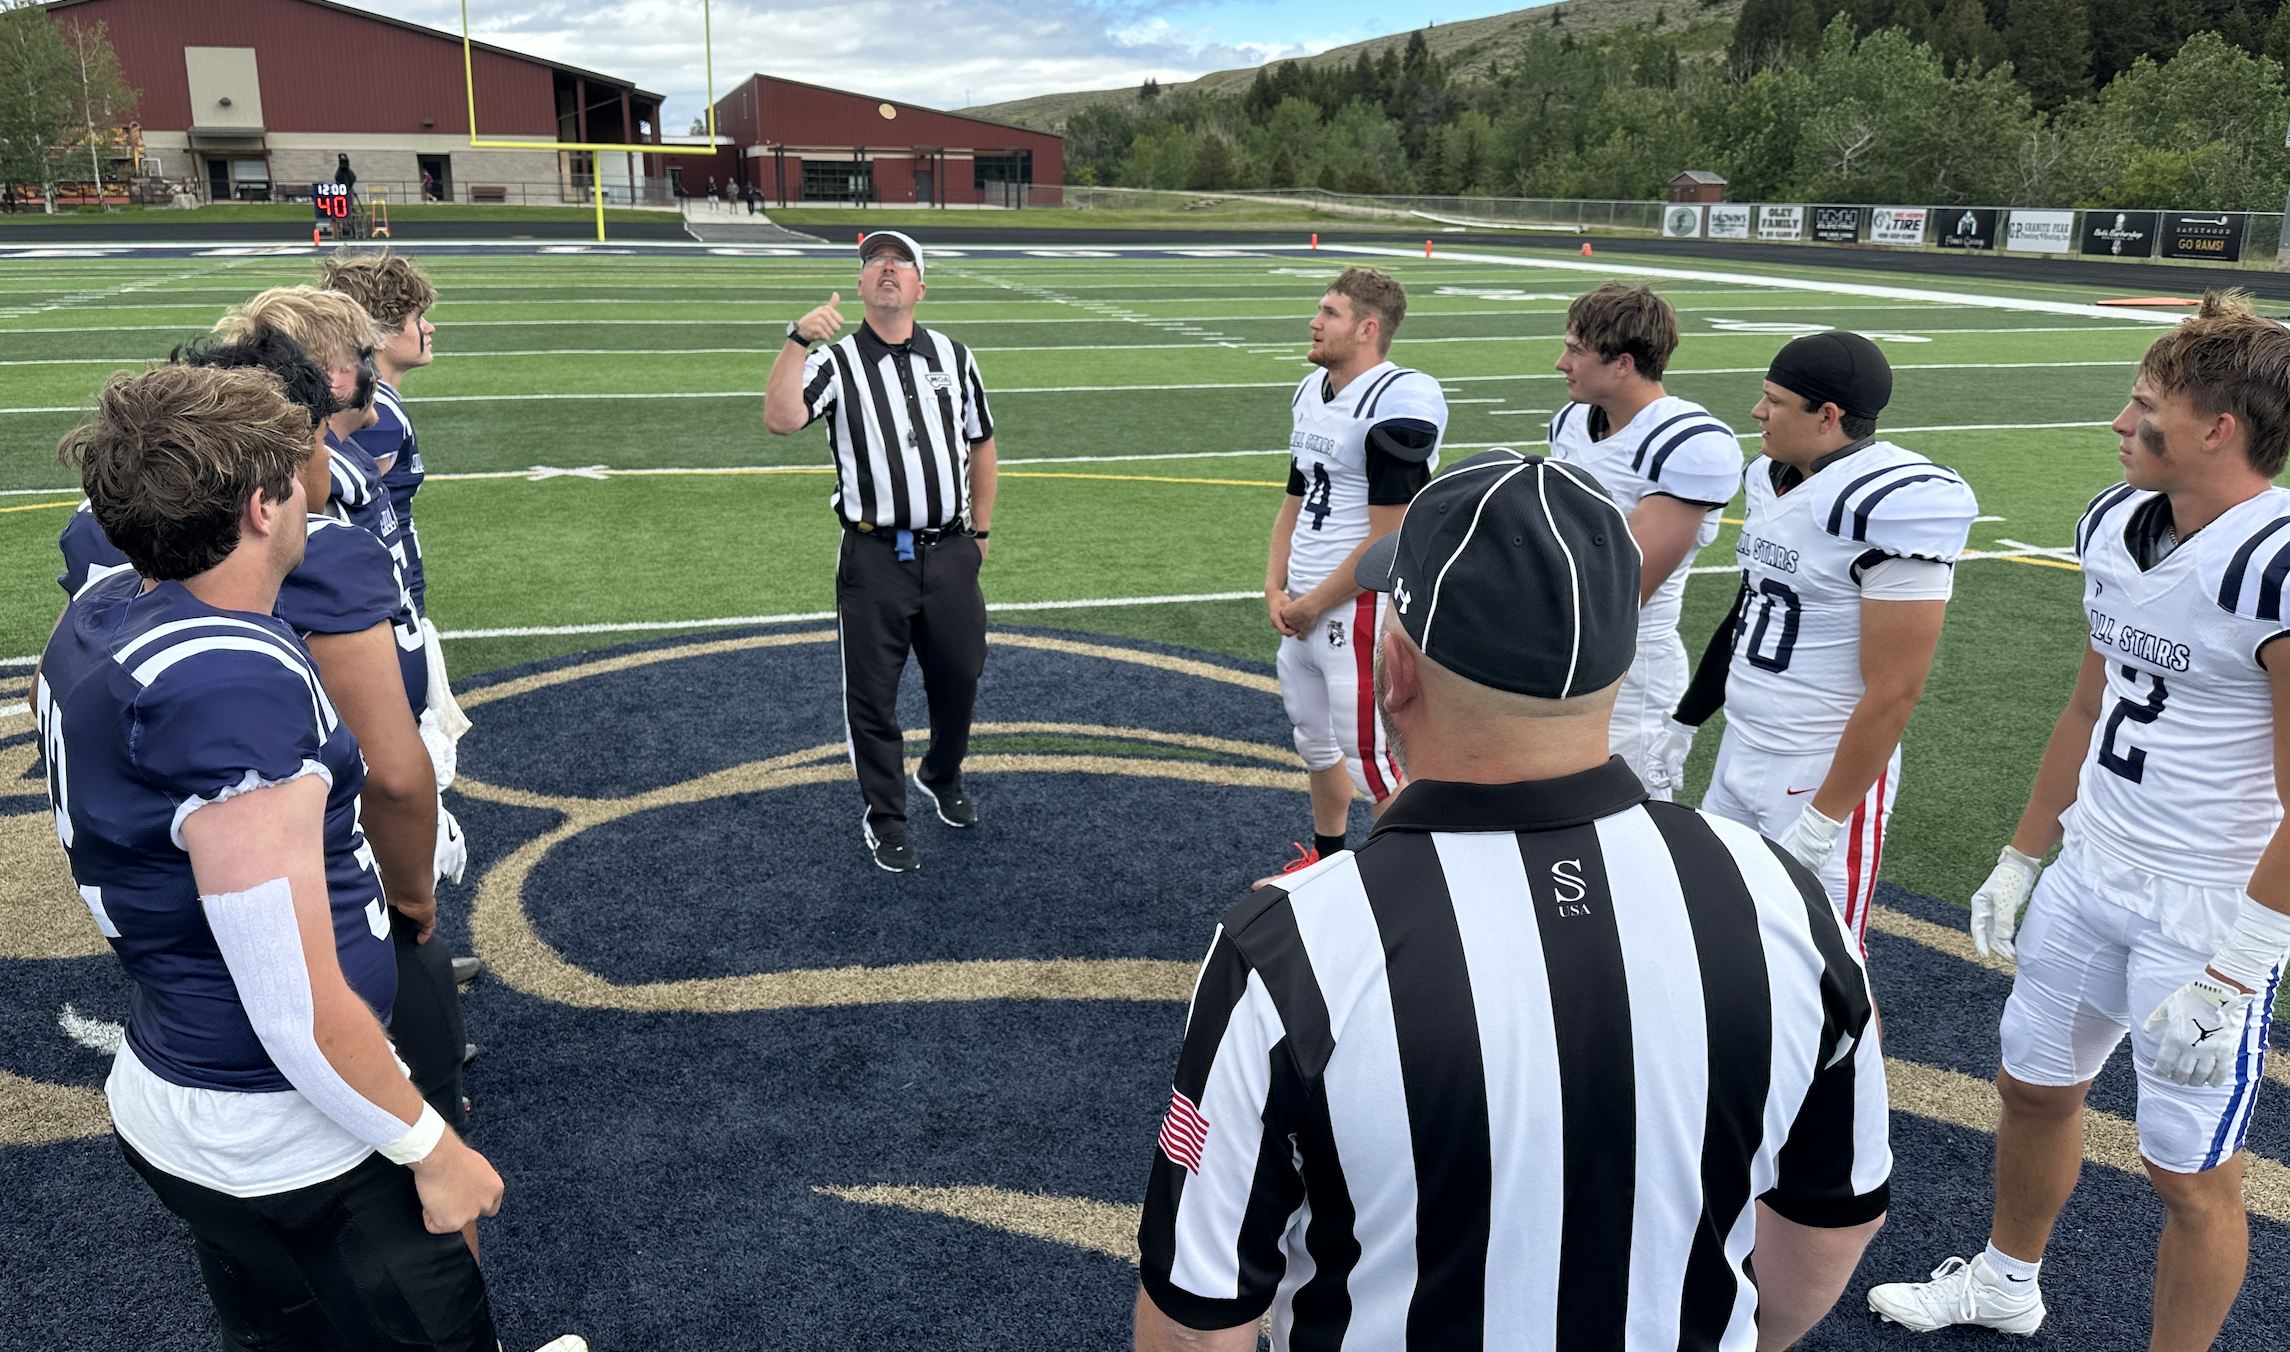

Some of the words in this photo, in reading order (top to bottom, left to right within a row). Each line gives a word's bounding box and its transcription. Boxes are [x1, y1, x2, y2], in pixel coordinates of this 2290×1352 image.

[317, 183, 348, 196] 12:00
[316, 196, 348, 218] 40
[1892, 219, 1922, 231] TIRE
[2052, 223, 2069, 234] PEAK
[2178, 238, 2194, 250] GO
[2195, 239, 2225, 252] RAMS!
[930, 376, 950, 384] MOA
[1305, 433, 1335, 456] STARS
[1753, 537, 1799, 574] STARS
[2118, 625, 2191, 673] STARS
[2097, 664, 2170, 786] 2
[1551, 858, 1587, 904] S
[1558, 903, 1592, 918] USA
